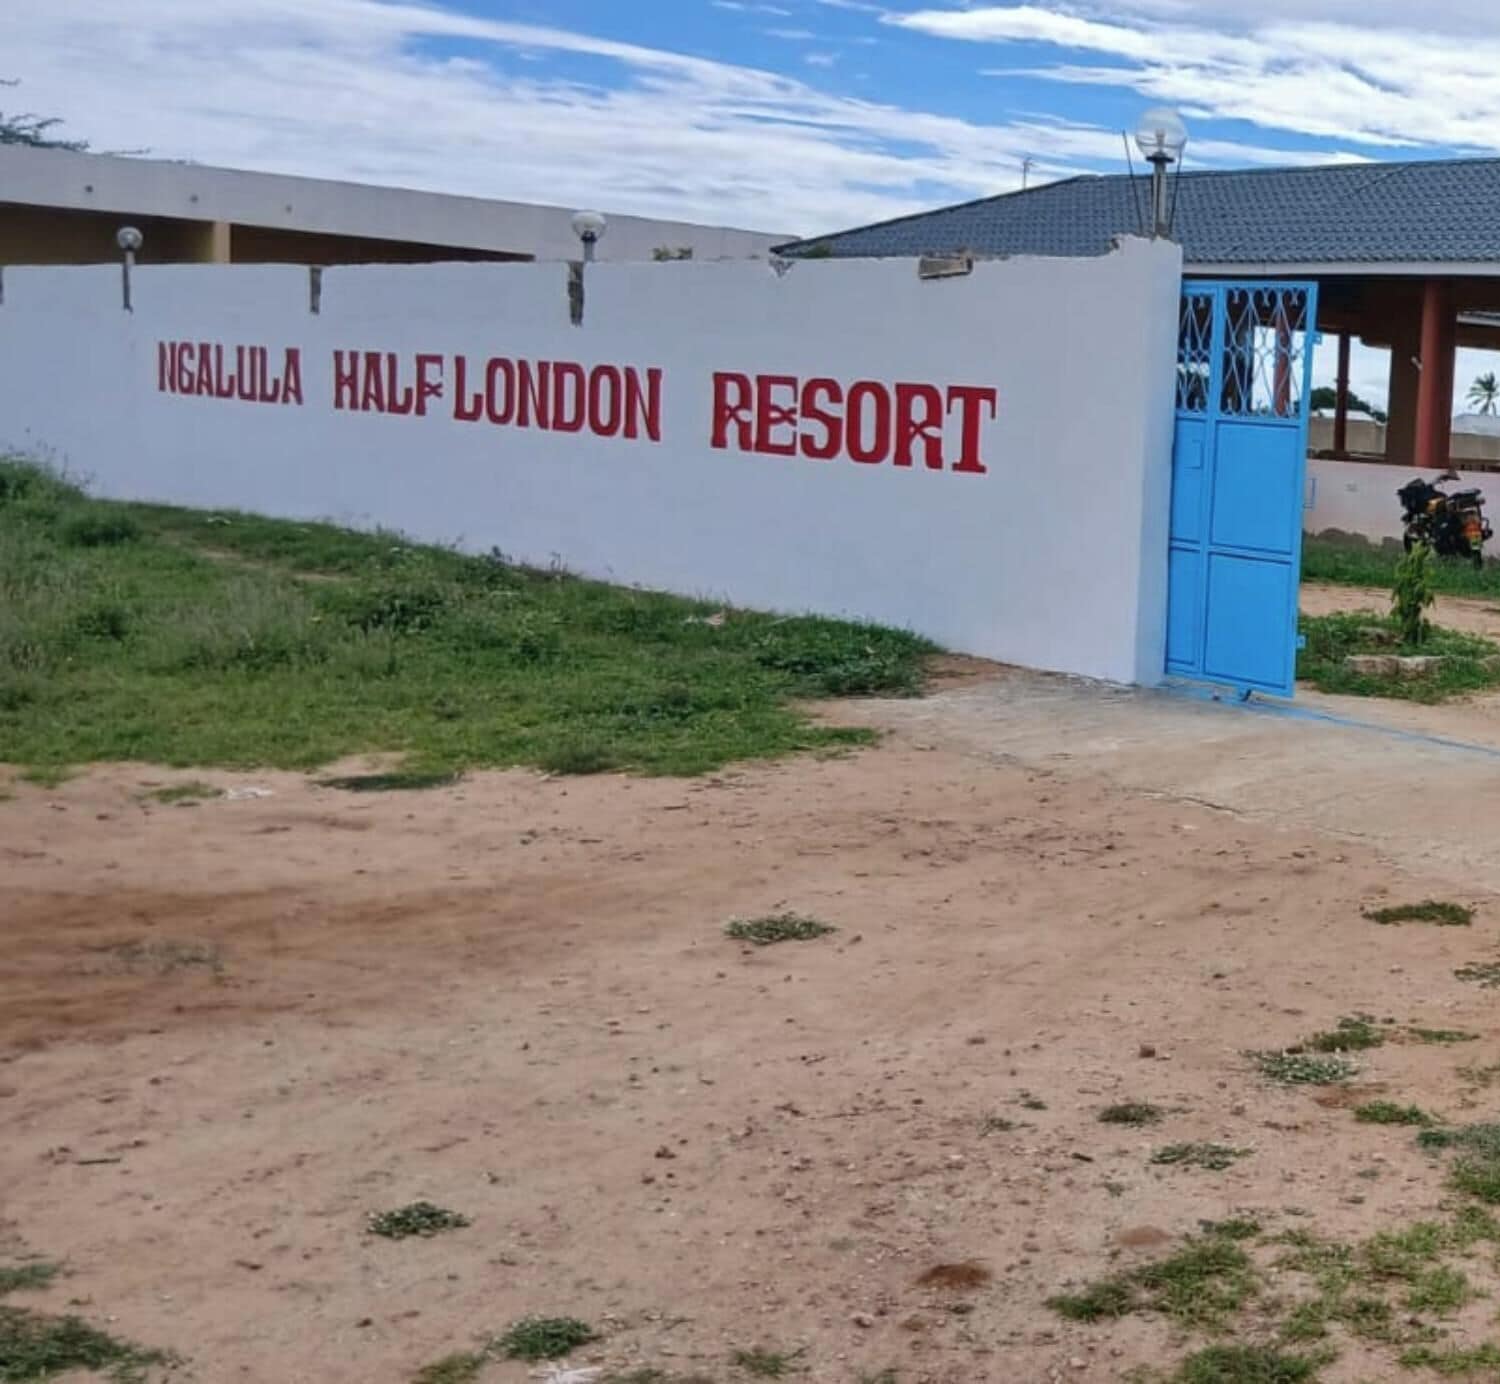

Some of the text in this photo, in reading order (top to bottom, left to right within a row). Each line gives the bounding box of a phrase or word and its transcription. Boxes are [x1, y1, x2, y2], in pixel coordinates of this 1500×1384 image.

[158, 340, 998, 474] NGALULA HALF LONDON RESORT
